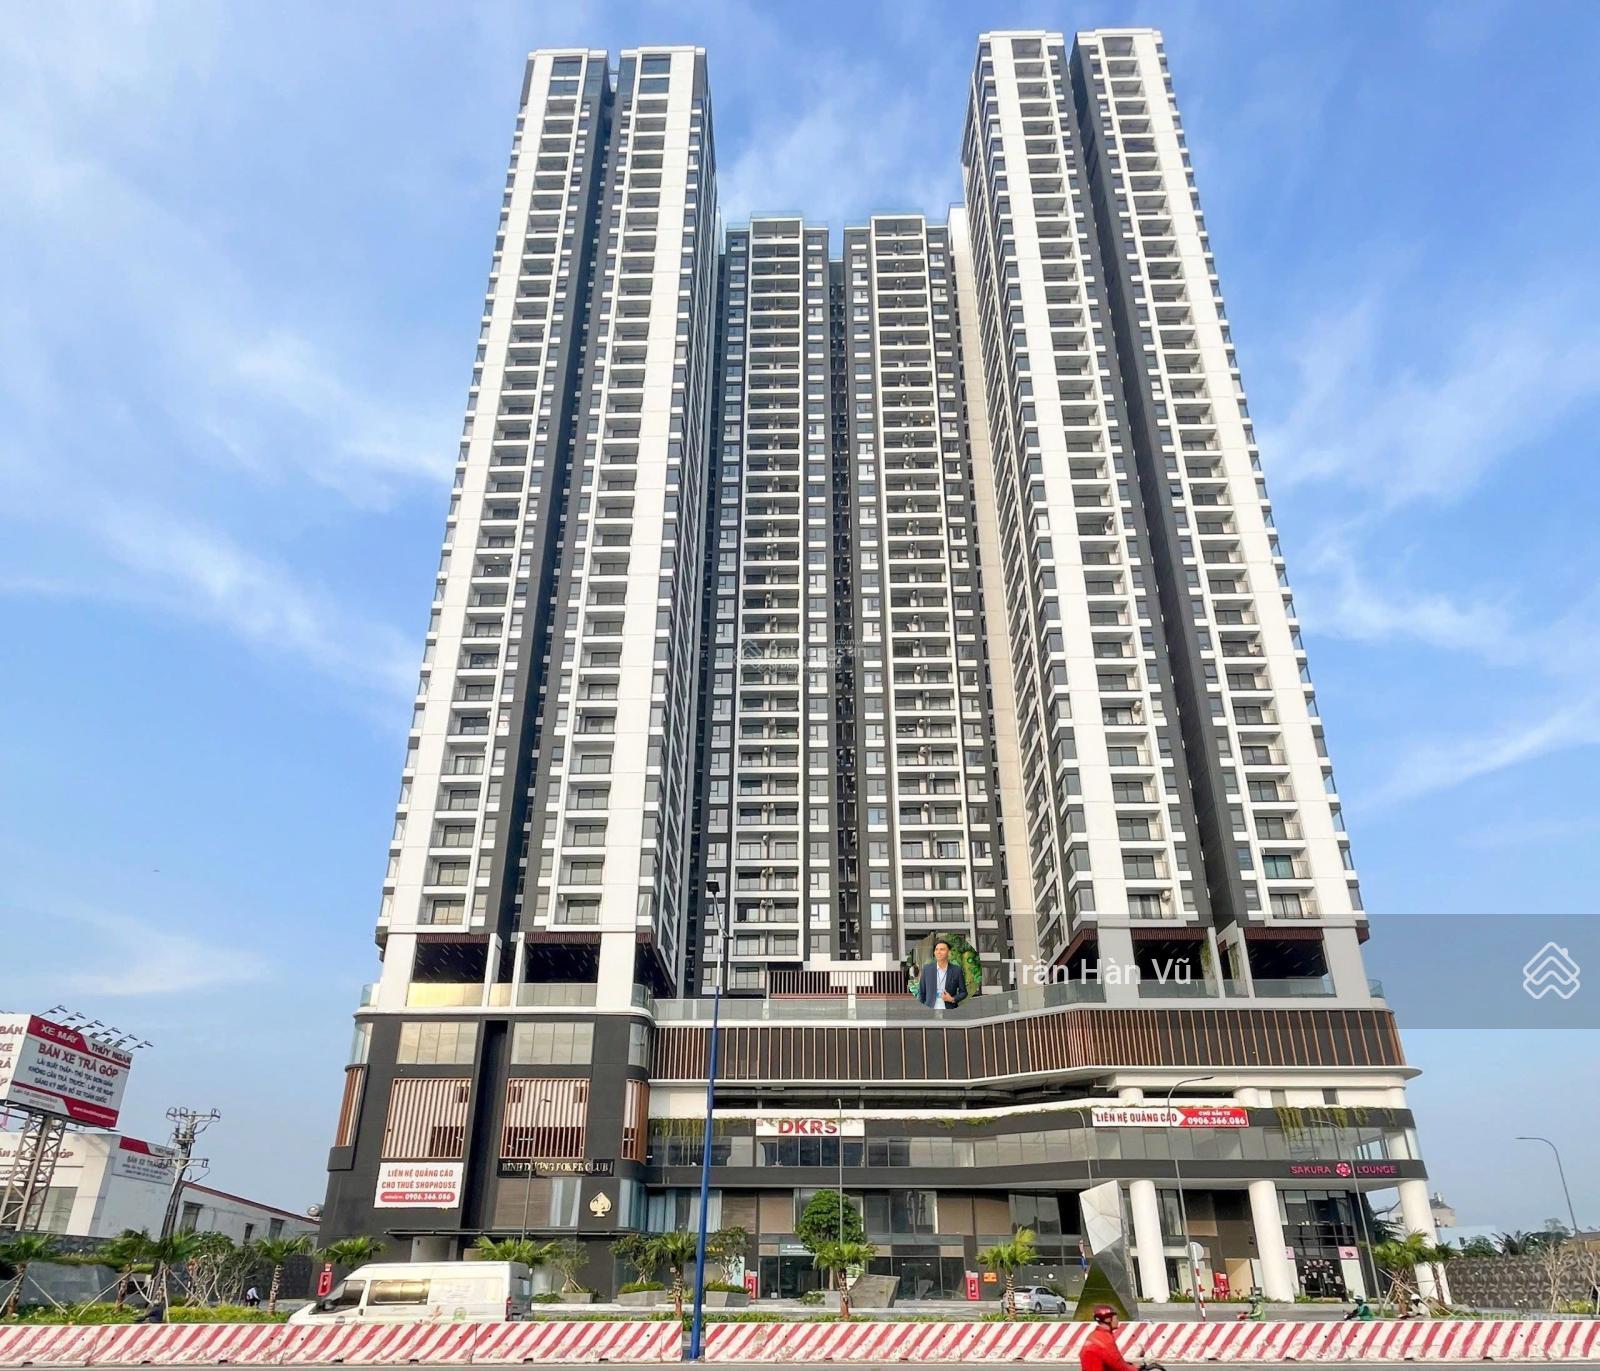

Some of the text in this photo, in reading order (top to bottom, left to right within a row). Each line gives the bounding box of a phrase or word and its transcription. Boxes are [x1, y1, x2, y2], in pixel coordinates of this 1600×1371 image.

[41, 1024, 79, 1043] XE MÁY
[38, 1043, 118, 1077] BÁN XE TRẢ GÓP
[1097, 1111, 1115, 1122] LIÊN
[1117, 1111, 1128, 1124] HỆ
[1131, 1110, 1159, 1123] QUẢNG
[1187, 1117, 1246, 1125] 0906.366.086
[778, 1119, 838, 1134] DKRS
[388, 1167, 454, 1178] LIÊN HỆ QUẢNG CÁO
[1290, 1165, 1398, 1174] SAKURA LOUNGE
[381, 1180, 457, 1189] CHO THUÊ SHOPHOUSE
